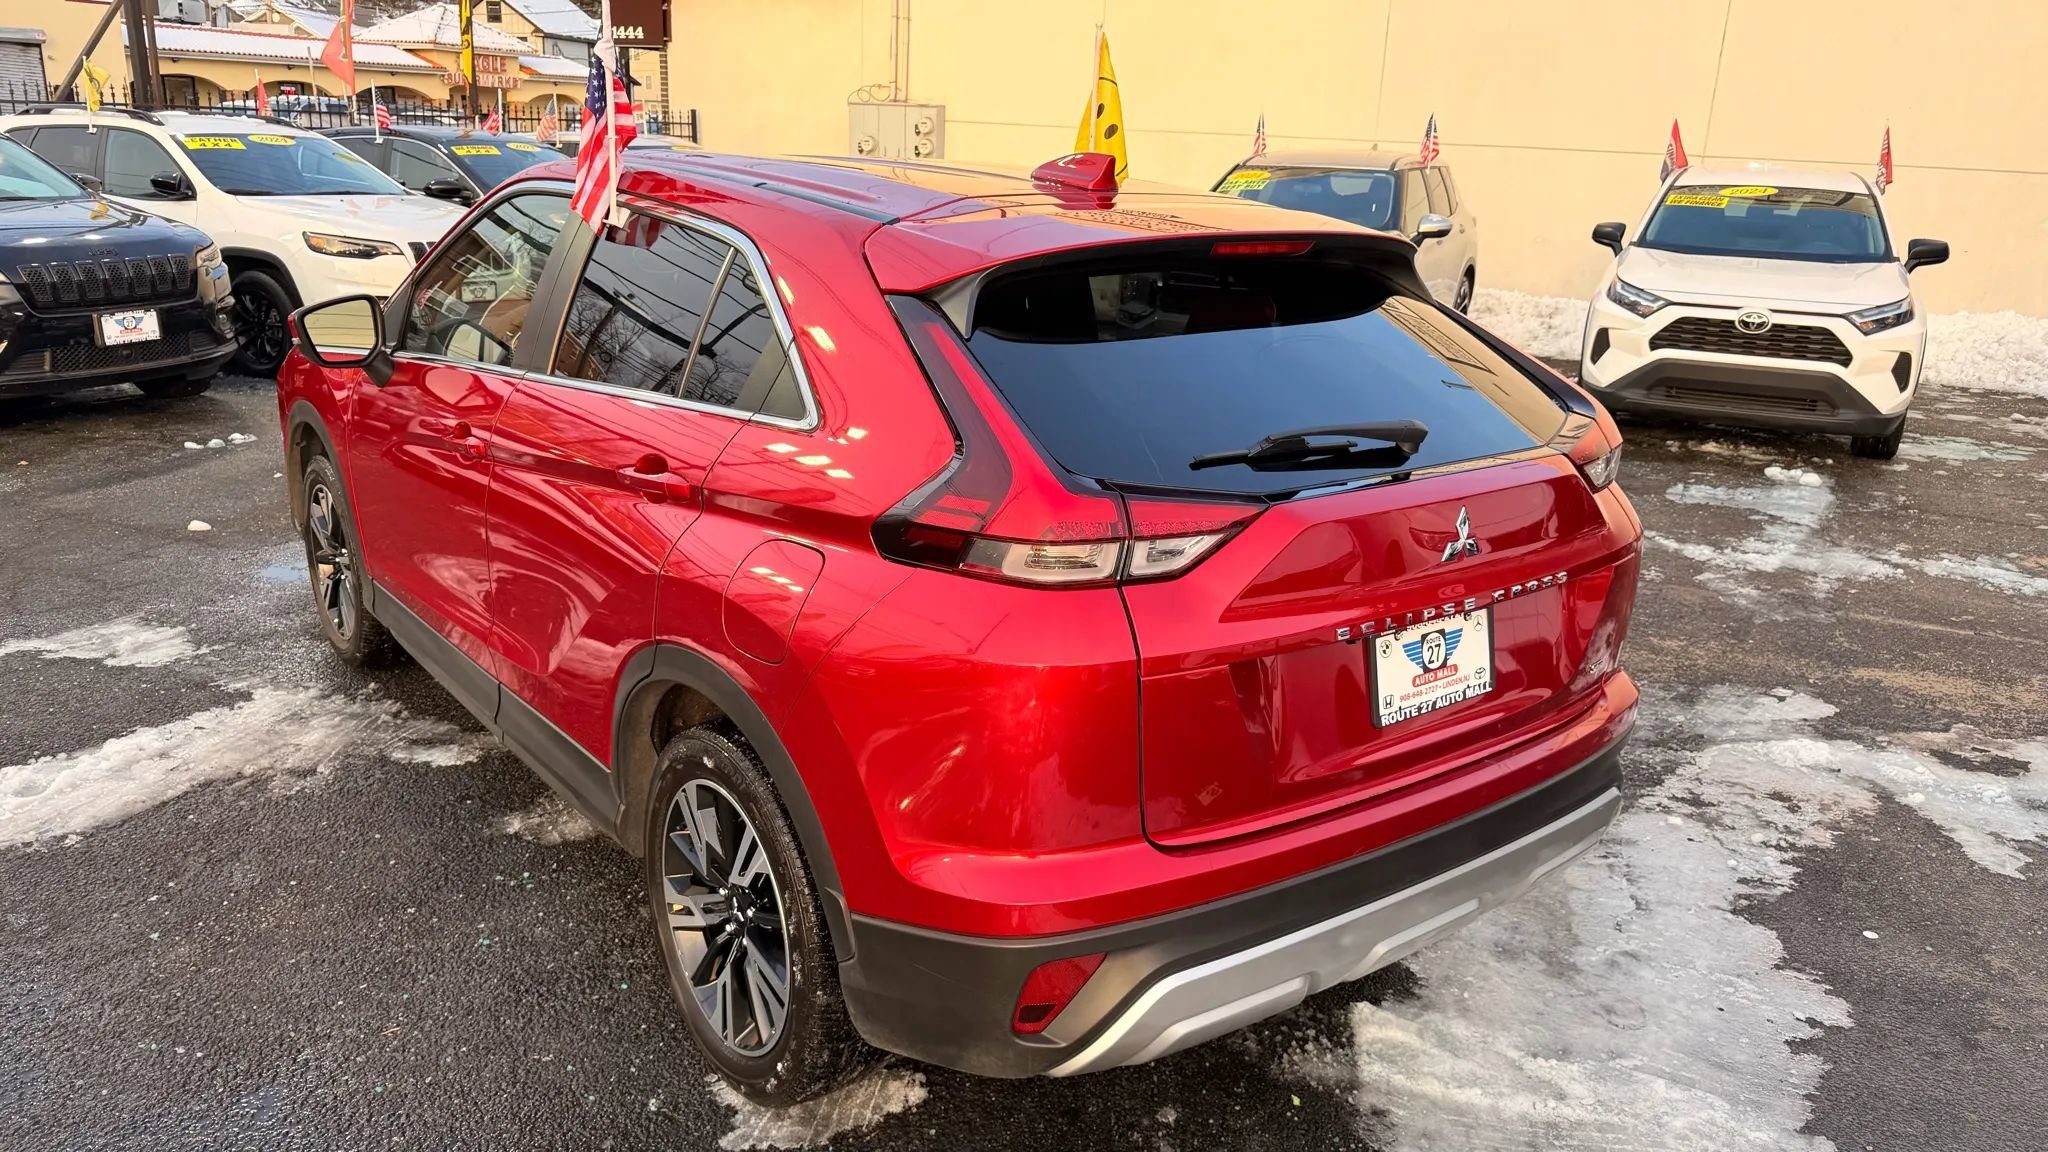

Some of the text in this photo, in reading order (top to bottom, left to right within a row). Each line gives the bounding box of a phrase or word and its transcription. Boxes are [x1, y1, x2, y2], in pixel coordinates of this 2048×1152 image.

[611, 25, 644, 39] 1444
[1729, 187, 1768, 195] 2024
[1336, 597, 1476, 641] ECLIPSE
[1491, 571, 1568, 603] CROSS
[1425, 635, 1441, 645] ROUTE
[1427, 643, 1441, 665] 27
[1414, 666, 1456, 688] AUTO MALL
[1381, 682, 1493, 727] ROUTE 27 AUTO MALL
